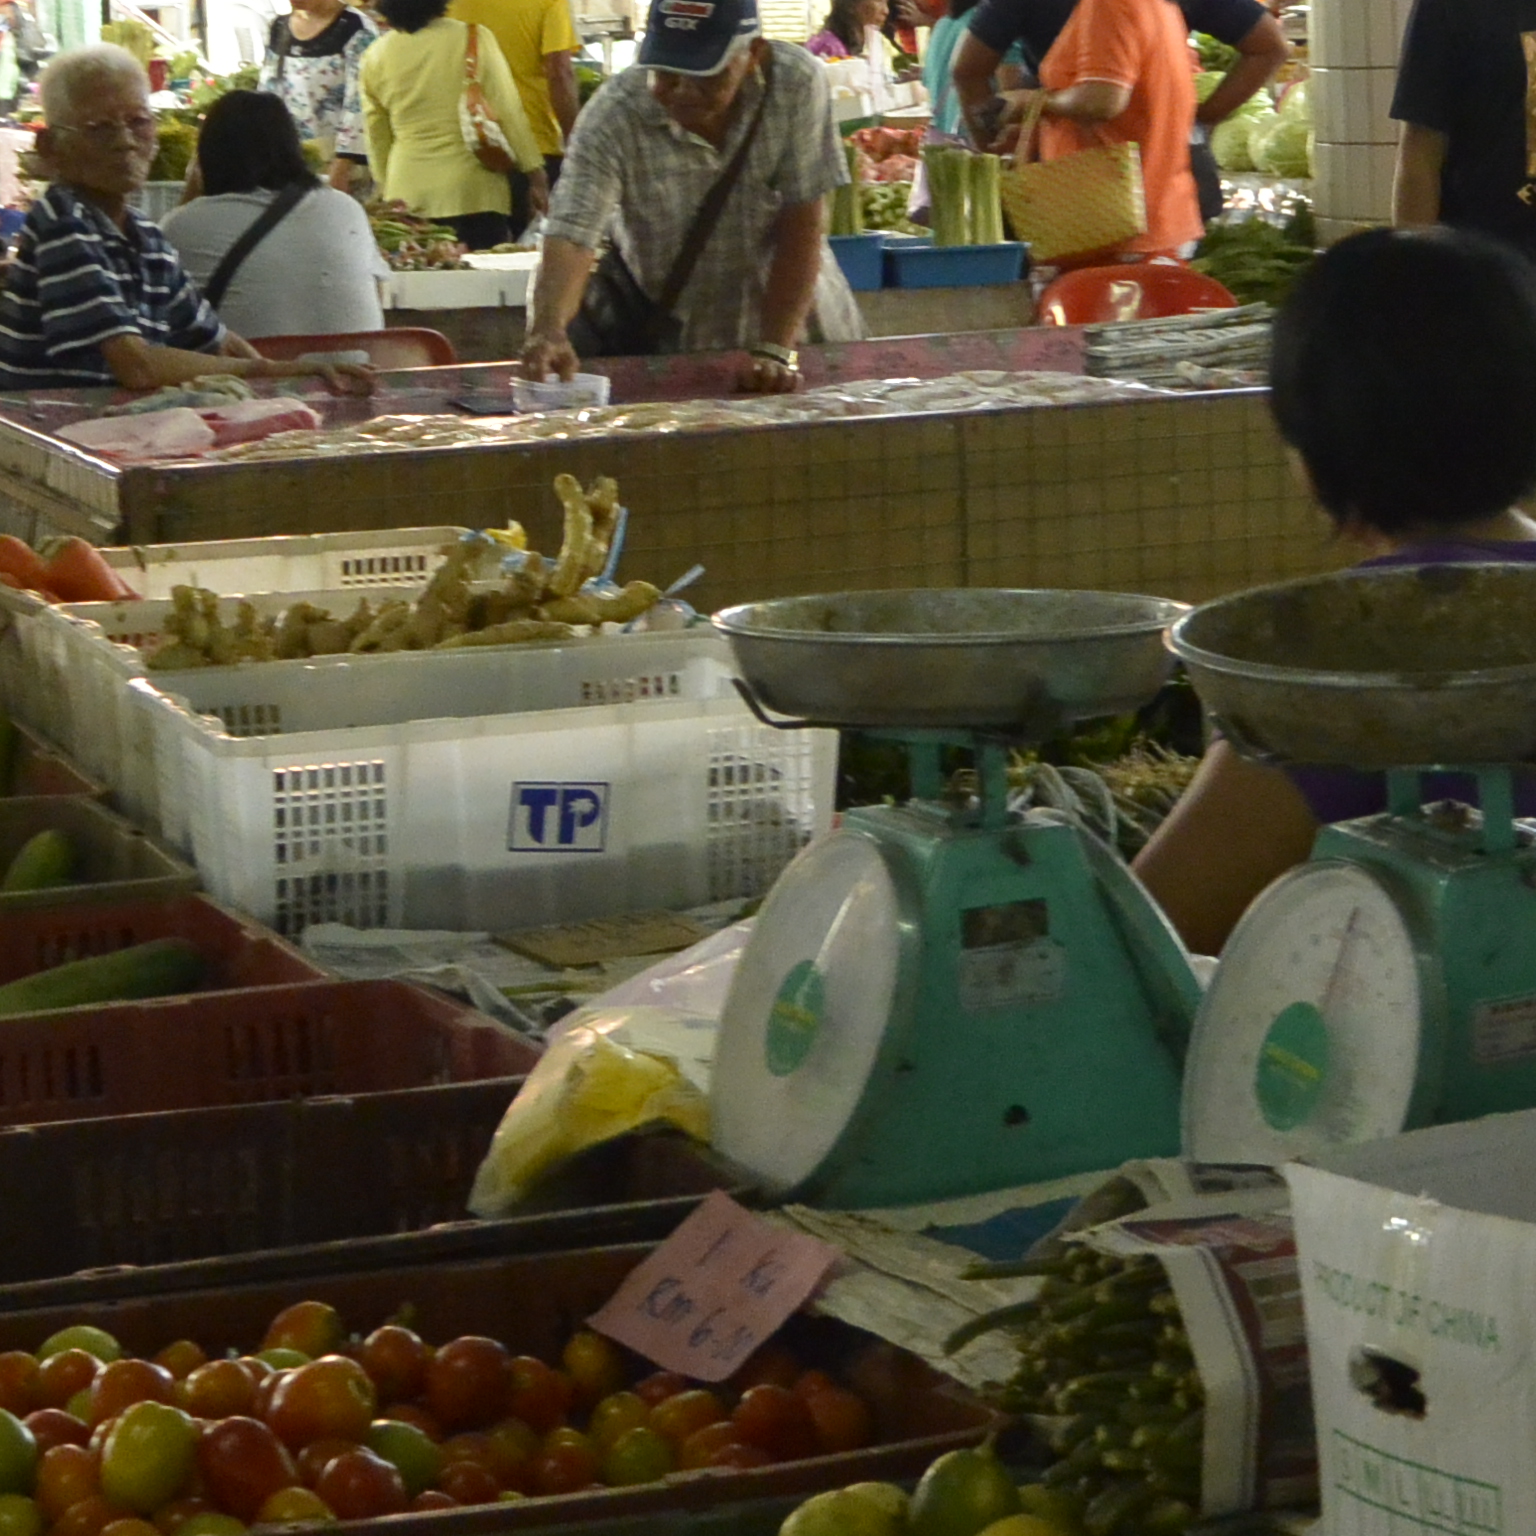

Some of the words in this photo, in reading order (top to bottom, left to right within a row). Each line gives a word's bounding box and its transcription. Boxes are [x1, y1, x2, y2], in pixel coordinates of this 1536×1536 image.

[517, 788, 601, 846] TP
[1312, 1260, 1392, 1319] PRODUCT
[1395, 1288, 1424, 1328] OF
[1428, 1299, 1501, 1353] CHINA
